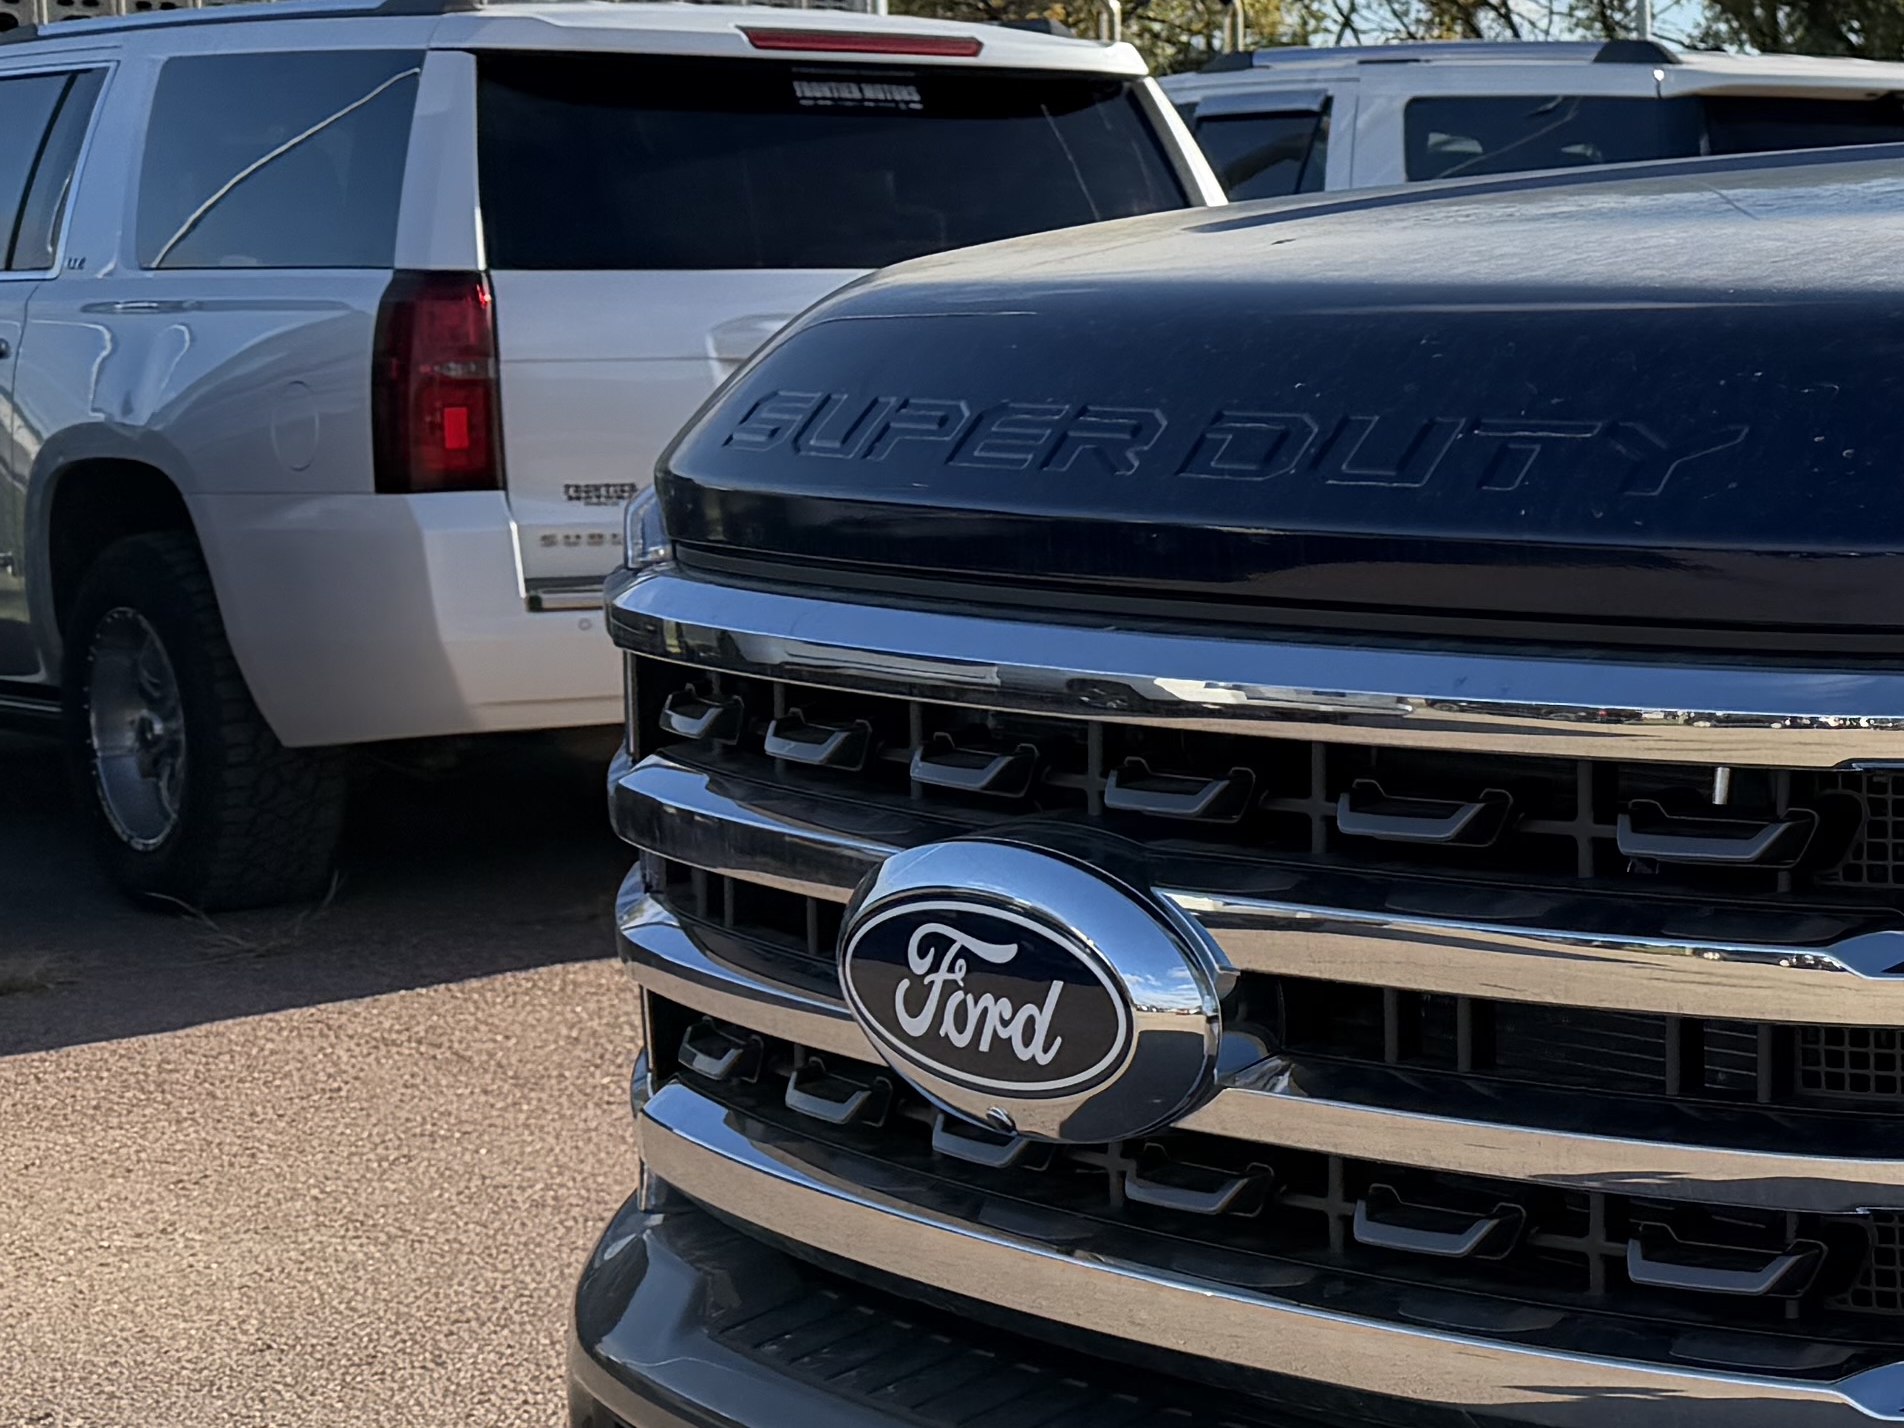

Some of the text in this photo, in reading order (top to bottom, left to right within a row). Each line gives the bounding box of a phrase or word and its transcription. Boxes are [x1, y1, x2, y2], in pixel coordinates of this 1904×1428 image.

[721, 389, 1751, 496] SUPER DUTY
[895, 922, 1064, 1066] Ford
